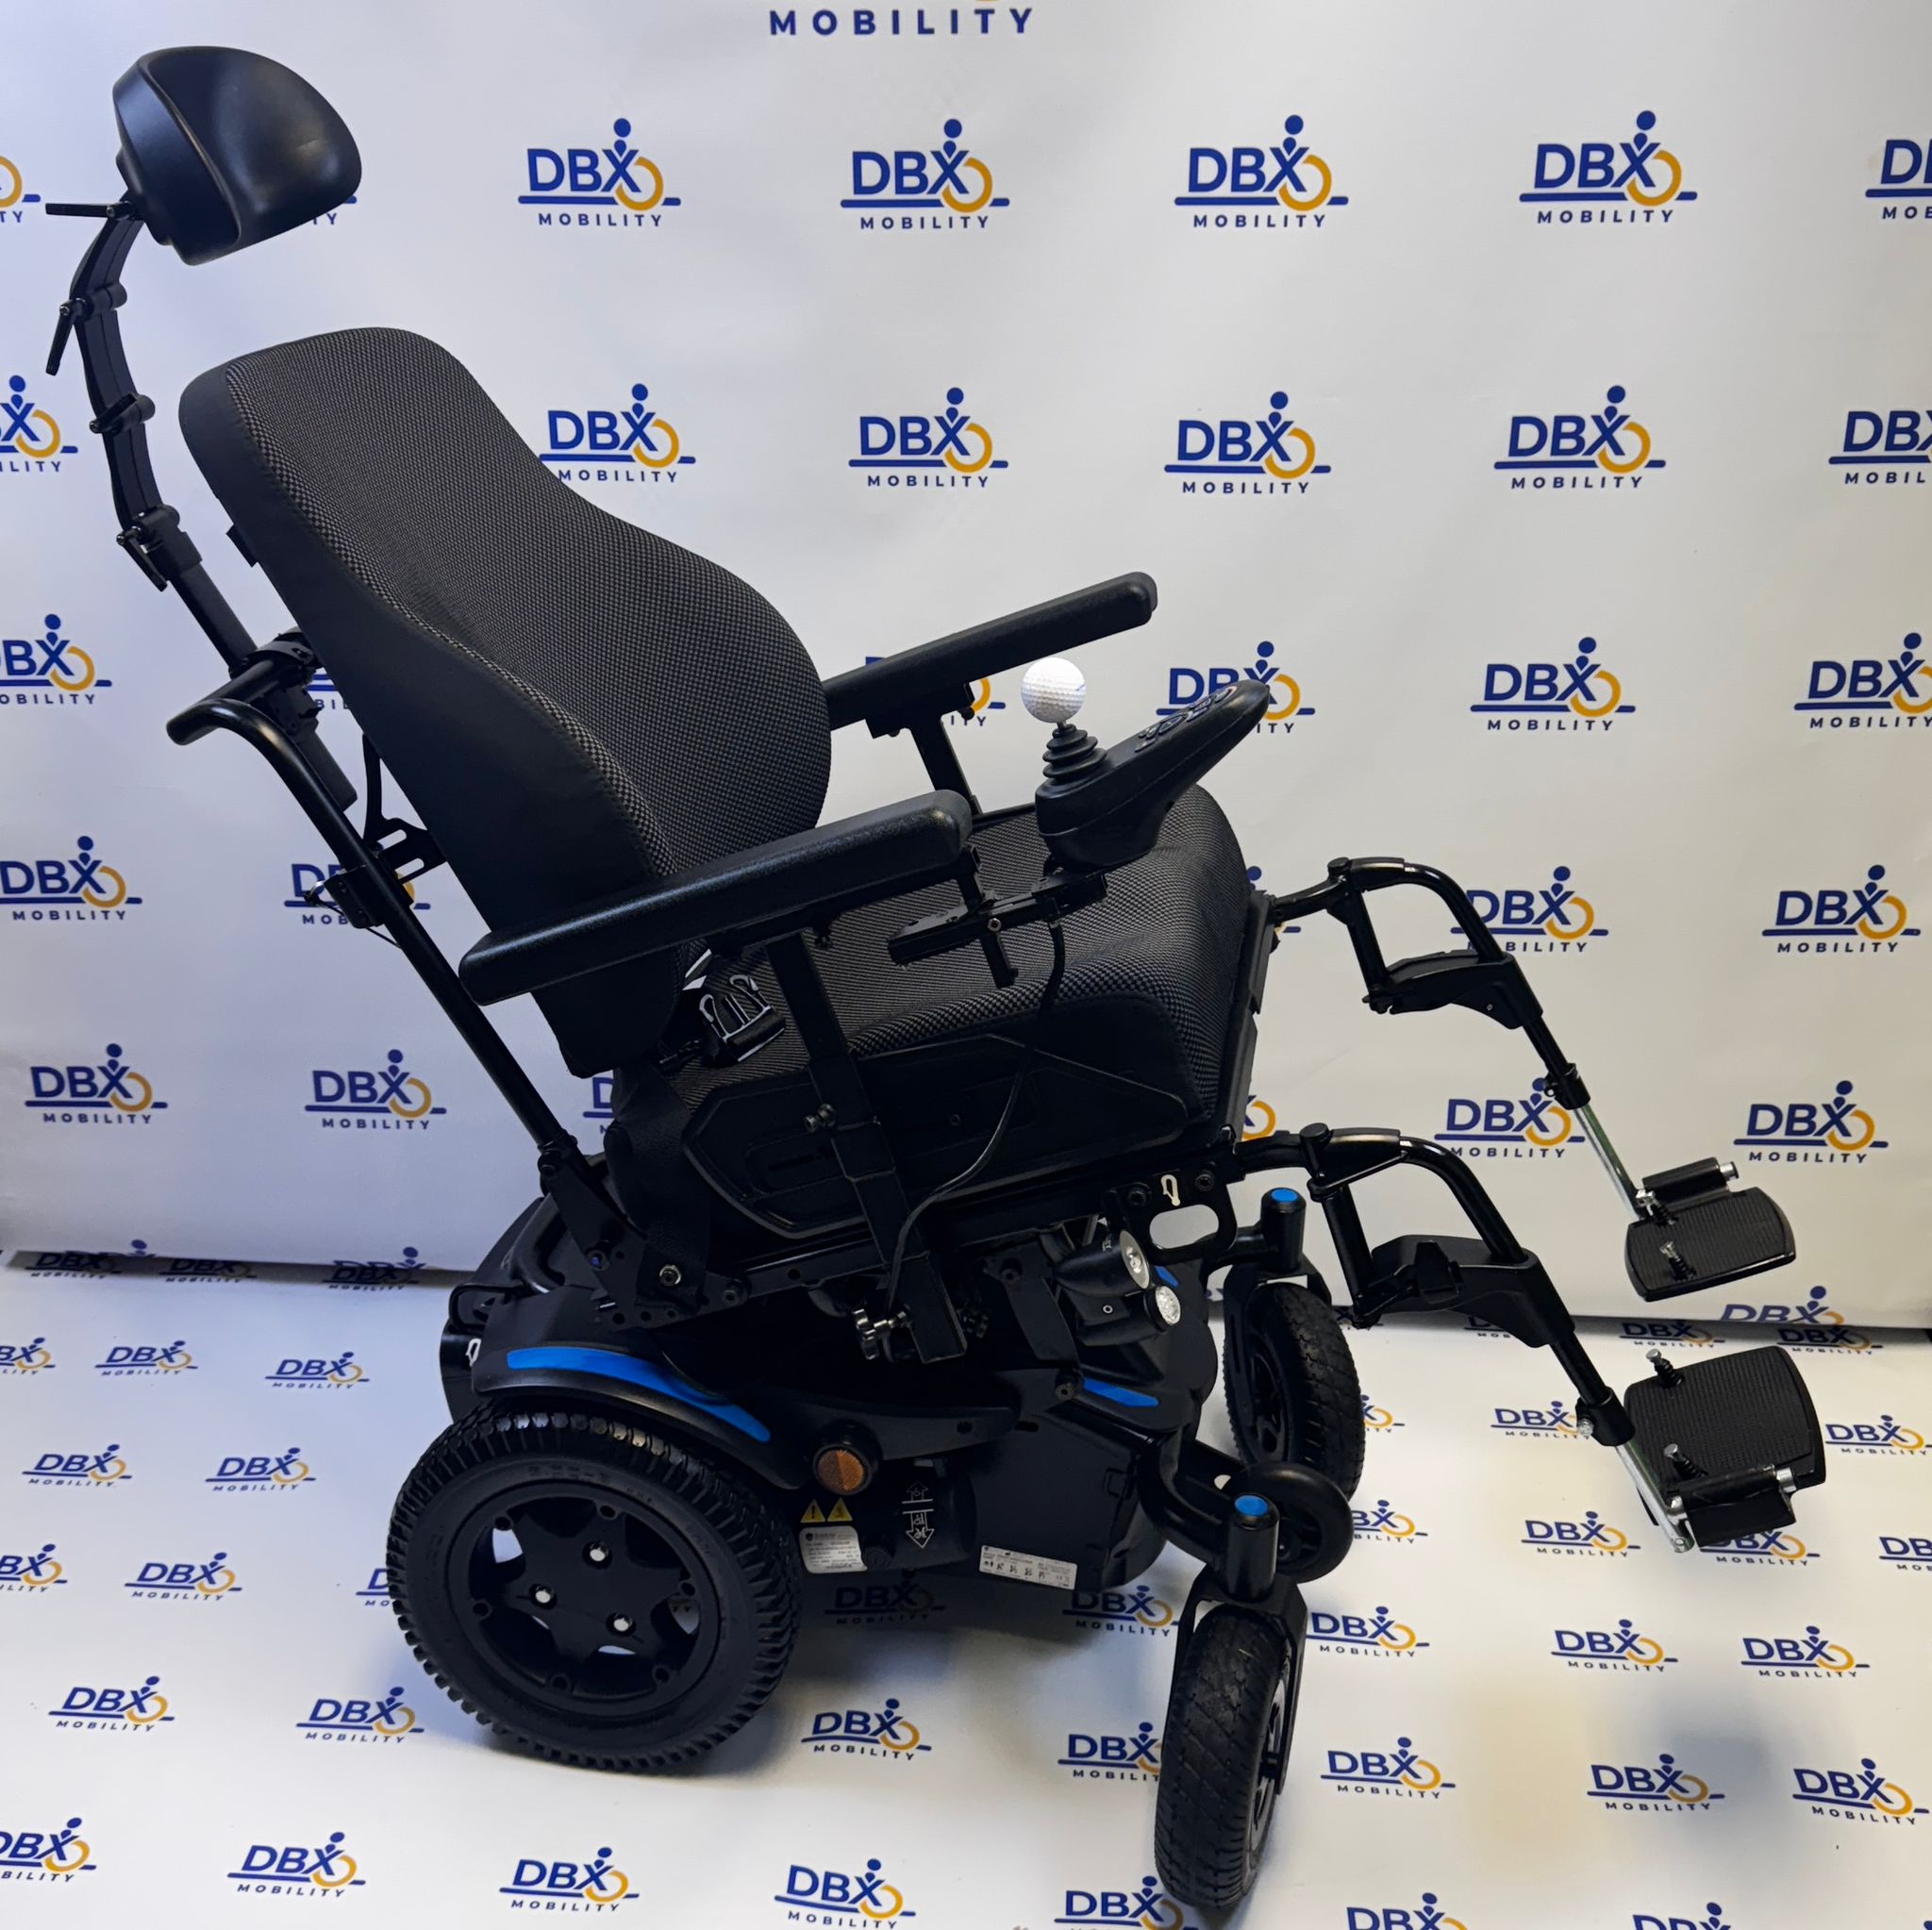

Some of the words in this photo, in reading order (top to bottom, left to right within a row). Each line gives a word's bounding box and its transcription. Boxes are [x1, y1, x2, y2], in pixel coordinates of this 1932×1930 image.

[770, 8, 1032, 36] MOBILITY
[527, 148, 641, 192] DBX
[853, 150, 969, 195] DBX
[1189, 147, 1308, 192] DBX
[1534, 142, 1660, 189] DBX
[539, 213, 661, 226] MOBILITY
[860, 216, 988, 229] MOBILITY
[1193, 215, 1324, 227] MOBILITY
[1538, 209, 1673, 224] MOBILITY
[548, 410, 658, 451] DBX
[860, 416, 970, 456] DBX
[1508, 415, 1630, 457] DBX
[1177, 420, 1293, 461] DBX
[559, 470, 676, 482] MOBILITY
[868, 475, 988, 488] MOBILITY
[1511, 476, 1641, 489] MOBILITY
[1845, 472, 1925, 484] MOBIL
[1183, 481, 1308, 493] MOBILITY
[0, 644, 74, 681] BX
[1484, 664, 1601, 702] DBX
[1808, 659, 1924, 699] DBX
[0, 693, 94, 705] OBILITY
[1488, 720, 1612, 731] MOBILITY
[1810, 716, 1932, 728] MOBILITY
[0, 860, 106, 894] DBX
[12, 910, 125, 921] MOBILITY
[1775, 890, 1889, 926] DBX
[1467, 941, 1586, 952] BILITY
[1777, 942, 1898, 953] MOBILITY
[30, 1066, 133, 1098] DBX
[312, 1070, 414, 1104] DBX
[43, 1113, 151, 1123] MOBILITY
[1446, 1093, 1553, 1133] DBX
[1747, 1104, 1857, 1137] DBX
[323, 1118, 429, 1130] MOBILITY
[1449, 1146, 1565, 1157] MOBILITY
[1749, 1152, 1866, 1163] MOBILITY
[1623, 1322, 1695, 1339] DBX
[1778, 1328, 1855, 1345] DBX
[0, 1345, 47, 1362] BX
[106, 1347, 183, 1364] DBX
[275, 1358, 354, 1376] DBX
[1495, 1407, 1573, 1427] DBX
[1825, 1423, 1907, 1443] DBX
[34, 1452, 116, 1472] DBX
[217, 1457, 300, 1476] DBX
[1354, 1510, 1397, 1529] BX
[1354, 1533, 1414, 1544] BILITY
[1525, 1520, 1609, 1542] DBX
[1537, 1548, 1627, 1557] MOBILITY
[1879, 1537, 1932, 1556] DB
[0, 1553, 52, 1576] BX
[1716, 1556, 1807, 1566] MOBILITY
[138, 1562, 225, 1585] DBX
[132, 1591, 222, 1600] MOBILITY
[1073, 1592, 1155, 1618] DBX
[1076, 1622, 1170, 1638] MOBILITY
[1313, 1612, 1398, 1640] DBX
[1320, 1645, 1414, 1656] MOBILITY
[1555, 1629, 1645, 1655] DBX
[1742, 1637, 1838, 1662] DBX
[1568, 1661, 1664, 1672] MOBILITY
[62, 1687, 157, 1713] DBX
[309, 1699, 406, 1722] DBX
[57, 1721, 153, 1731] MOBILITY
[812, 1709, 903, 1739] DBX
[306, 1733, 404, 1742] MOBILITY
[814, 1744, 913, 1760] MOBILITY
[1068, 1733, 1158, 1763] DBX
[1327, 1749, 1422, 1779] DBX
[1073, 1769, 1159, 1782] MOBILIT
[1591, 1765, 1689, 1793] DBX
[1338, 1785, 1440, 1799] MOBILITY
[1794, 1768, 1893, 1803] DBX
[1606, 1803, 1710, 1811] MOBILITY
[1812, 1805, 1915, 1824] MOBILITY
[242, 1844, 343, 1875] DBX
[1, 1871, 74, 1882] BILITY
[512, 1859, 612, 1890] DBX
[238, 1884, 343, 1897] MOBILITY
[787, 1864, 884, 1906] DBX
[511, 1900, 619, 1911] MOBILITY
[1065, 1889, 1164, 1922] DBX
[789, 1911, 896, 1929] MOBILITY
